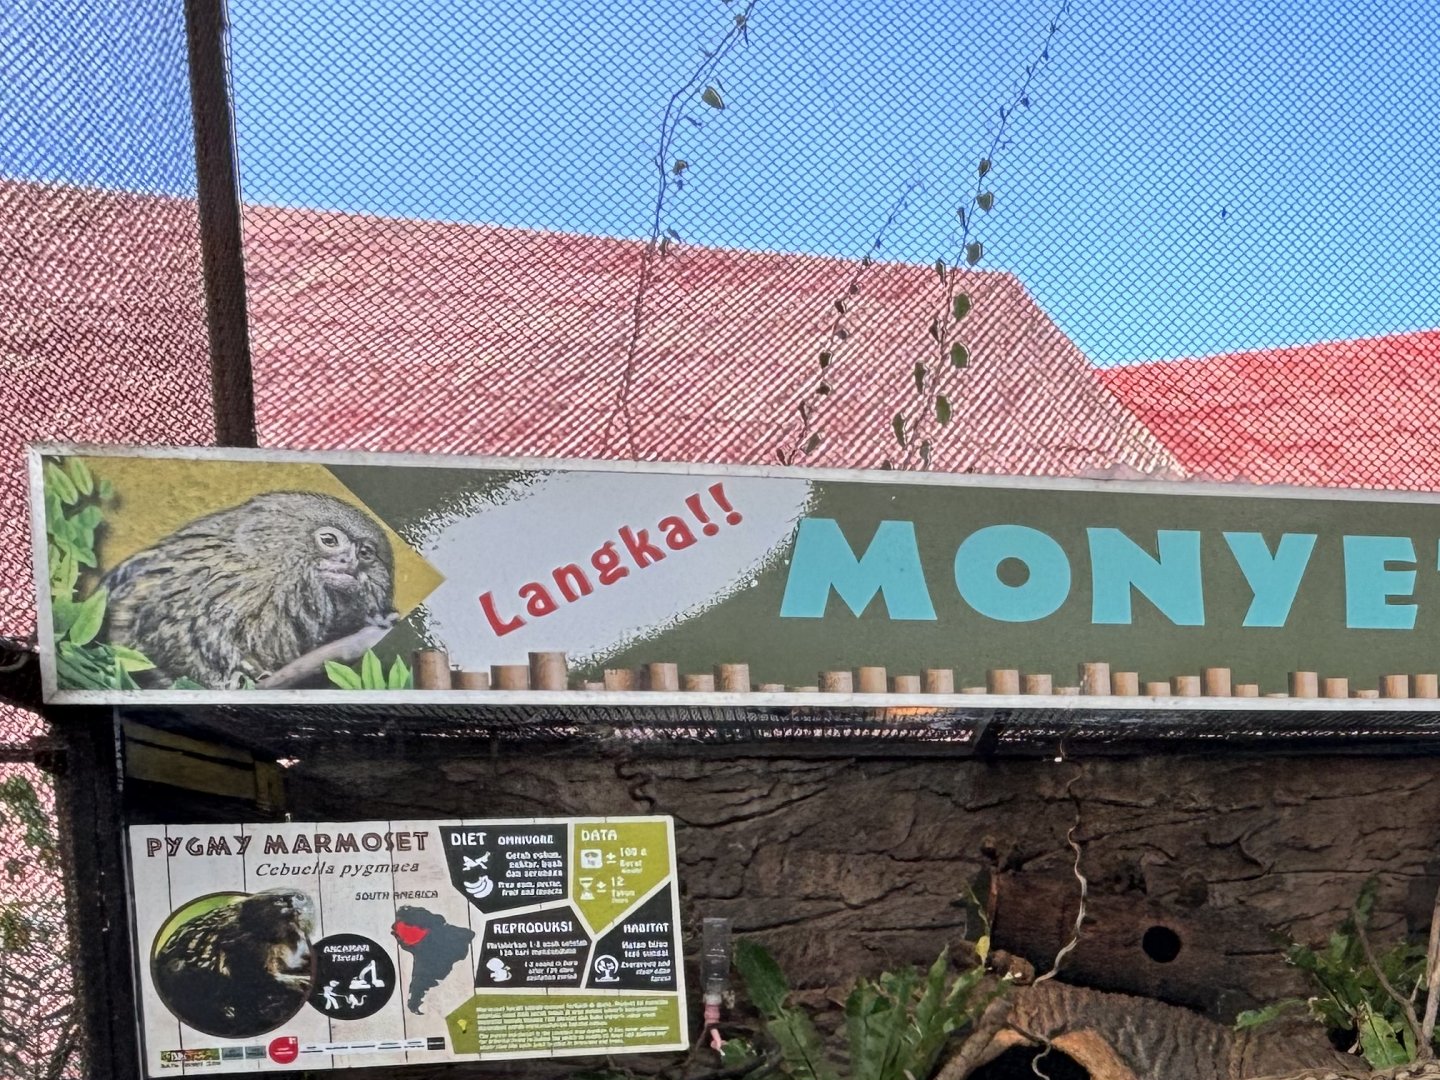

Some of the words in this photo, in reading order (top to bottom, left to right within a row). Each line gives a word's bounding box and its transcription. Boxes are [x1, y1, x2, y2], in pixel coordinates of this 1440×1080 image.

[478, 482, 743, 637] Langka!!
[451, 832, 487, 846] DIET
[498, 835, 554, 846] OMNIVORE
[581, 829, 618, 841] DATA
[146, 835, 252, 857] PYGMY
[264, 831, 429, 854] MARMOSET
[255, 861, 335, 877] Cebuella
[339, 861, 420, 878] pygmaea
[355, 891, 390, 901] SOUTH
[393, 890, 439, 900] AMERICA
[493, 921, 573, 934] REPRODUKSI
[623, 922, 670, 934] HABITAT
